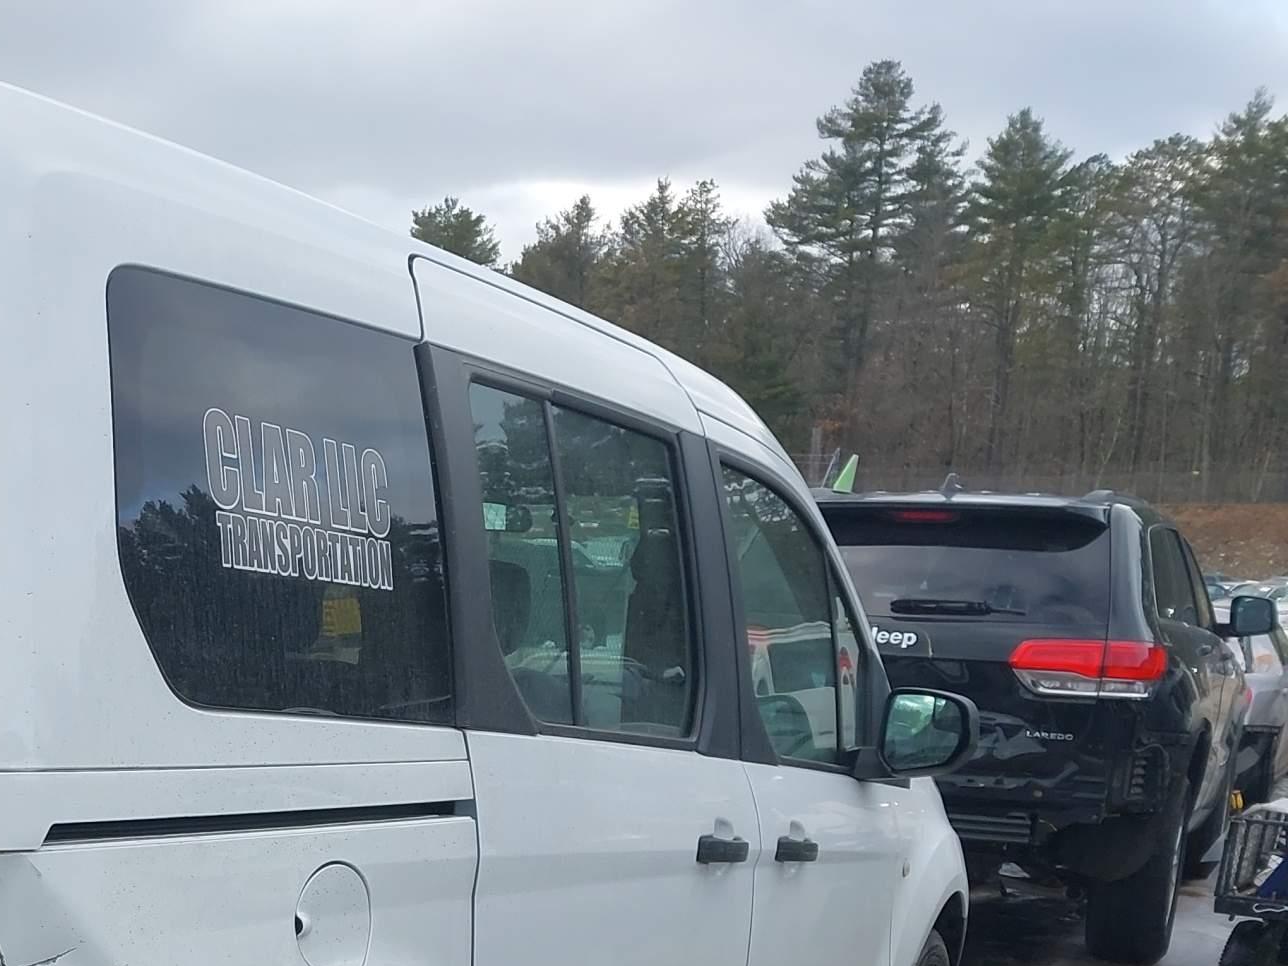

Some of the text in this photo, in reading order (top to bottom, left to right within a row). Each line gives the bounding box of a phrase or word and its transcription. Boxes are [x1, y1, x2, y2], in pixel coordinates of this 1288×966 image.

[203, 408, 391, 538] CLAR LLC
[216, 510, 394, 591] TRANSPORTATION
[1025, 730, 1074, 741] LAREDO
